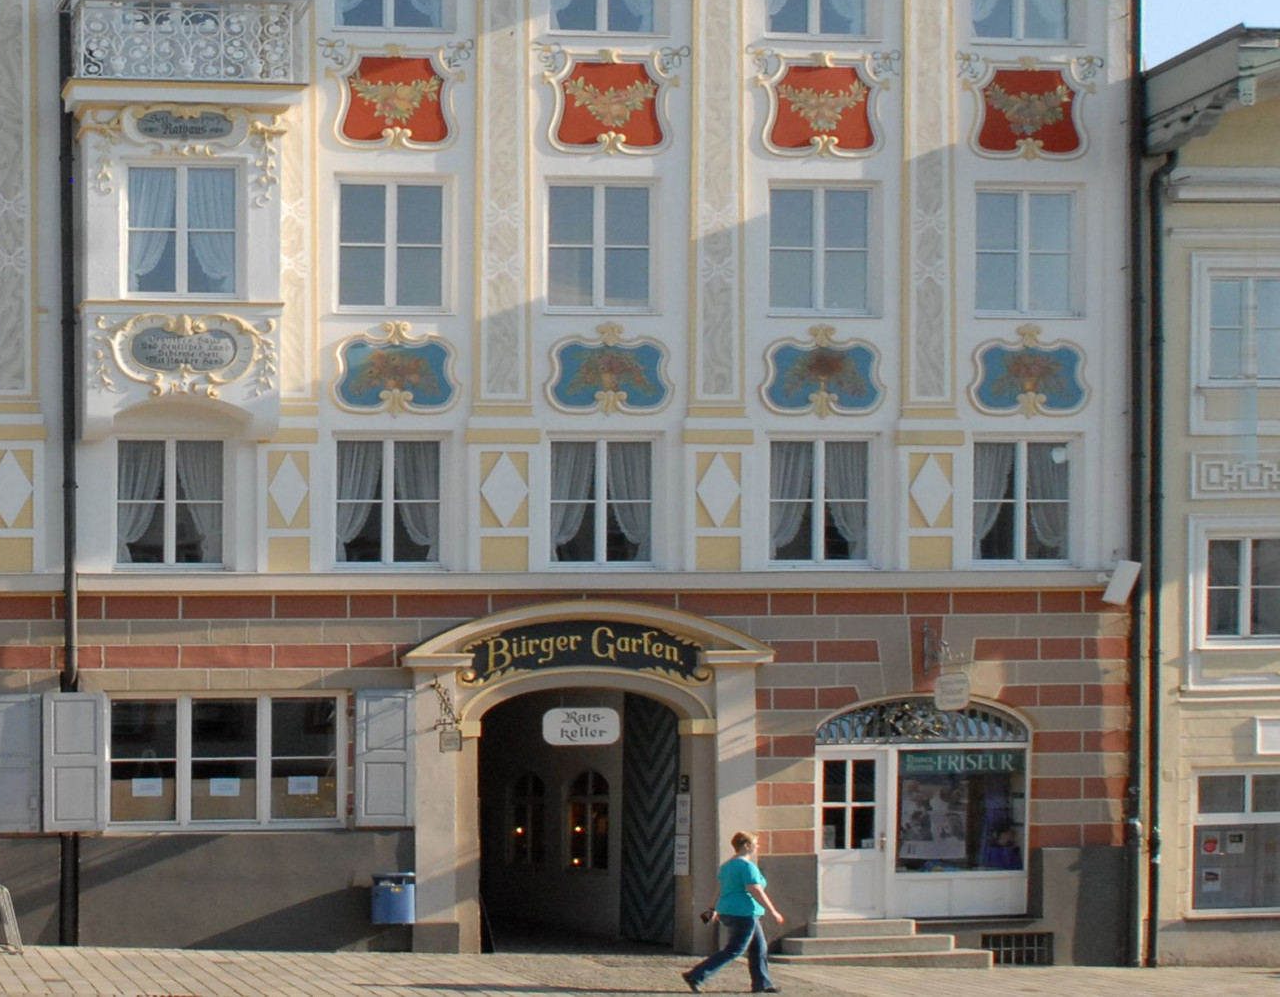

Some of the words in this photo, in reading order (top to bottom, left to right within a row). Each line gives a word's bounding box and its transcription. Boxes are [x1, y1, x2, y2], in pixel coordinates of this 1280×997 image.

[484, 632, 582, 675] Bürger
[562, 711, 606, 726] Rats-
[937, 753, 1015, 773] FRISEUR
